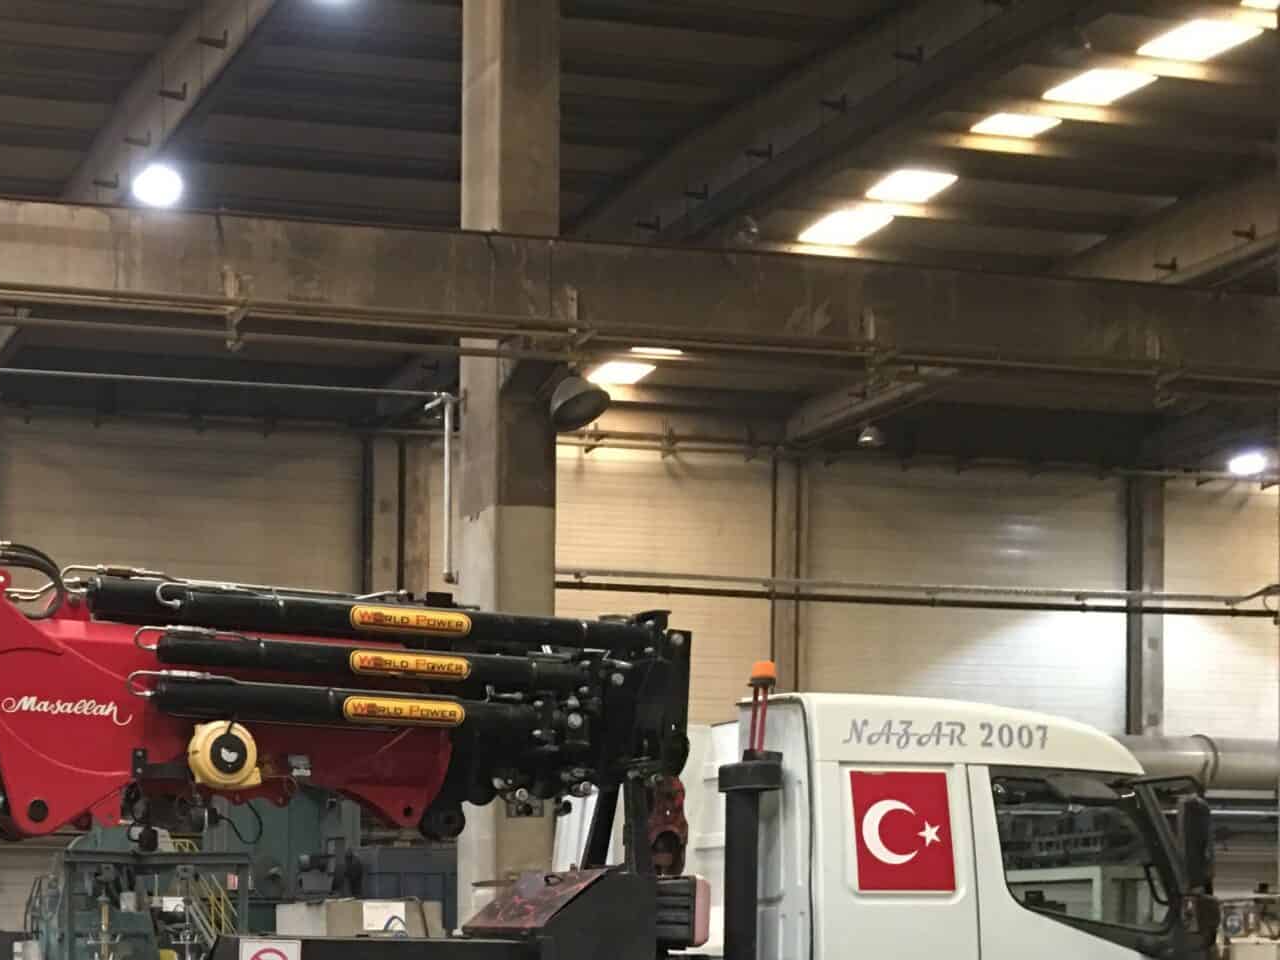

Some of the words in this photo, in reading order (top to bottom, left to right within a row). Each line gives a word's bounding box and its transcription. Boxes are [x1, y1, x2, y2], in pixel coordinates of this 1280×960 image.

[360, 611, 410, 625] WORLD
[415, 614, 464, 628] POWER
[359, 655, 409, 669] WORLD
[415, 658, 464, 673] POWER
[351, 702, 403, 715] WORLD
[409, 704, 457, 718] POWER
[841, 719, 968, 749] NAZAR
[979, 722, 1049, 749] 2007
